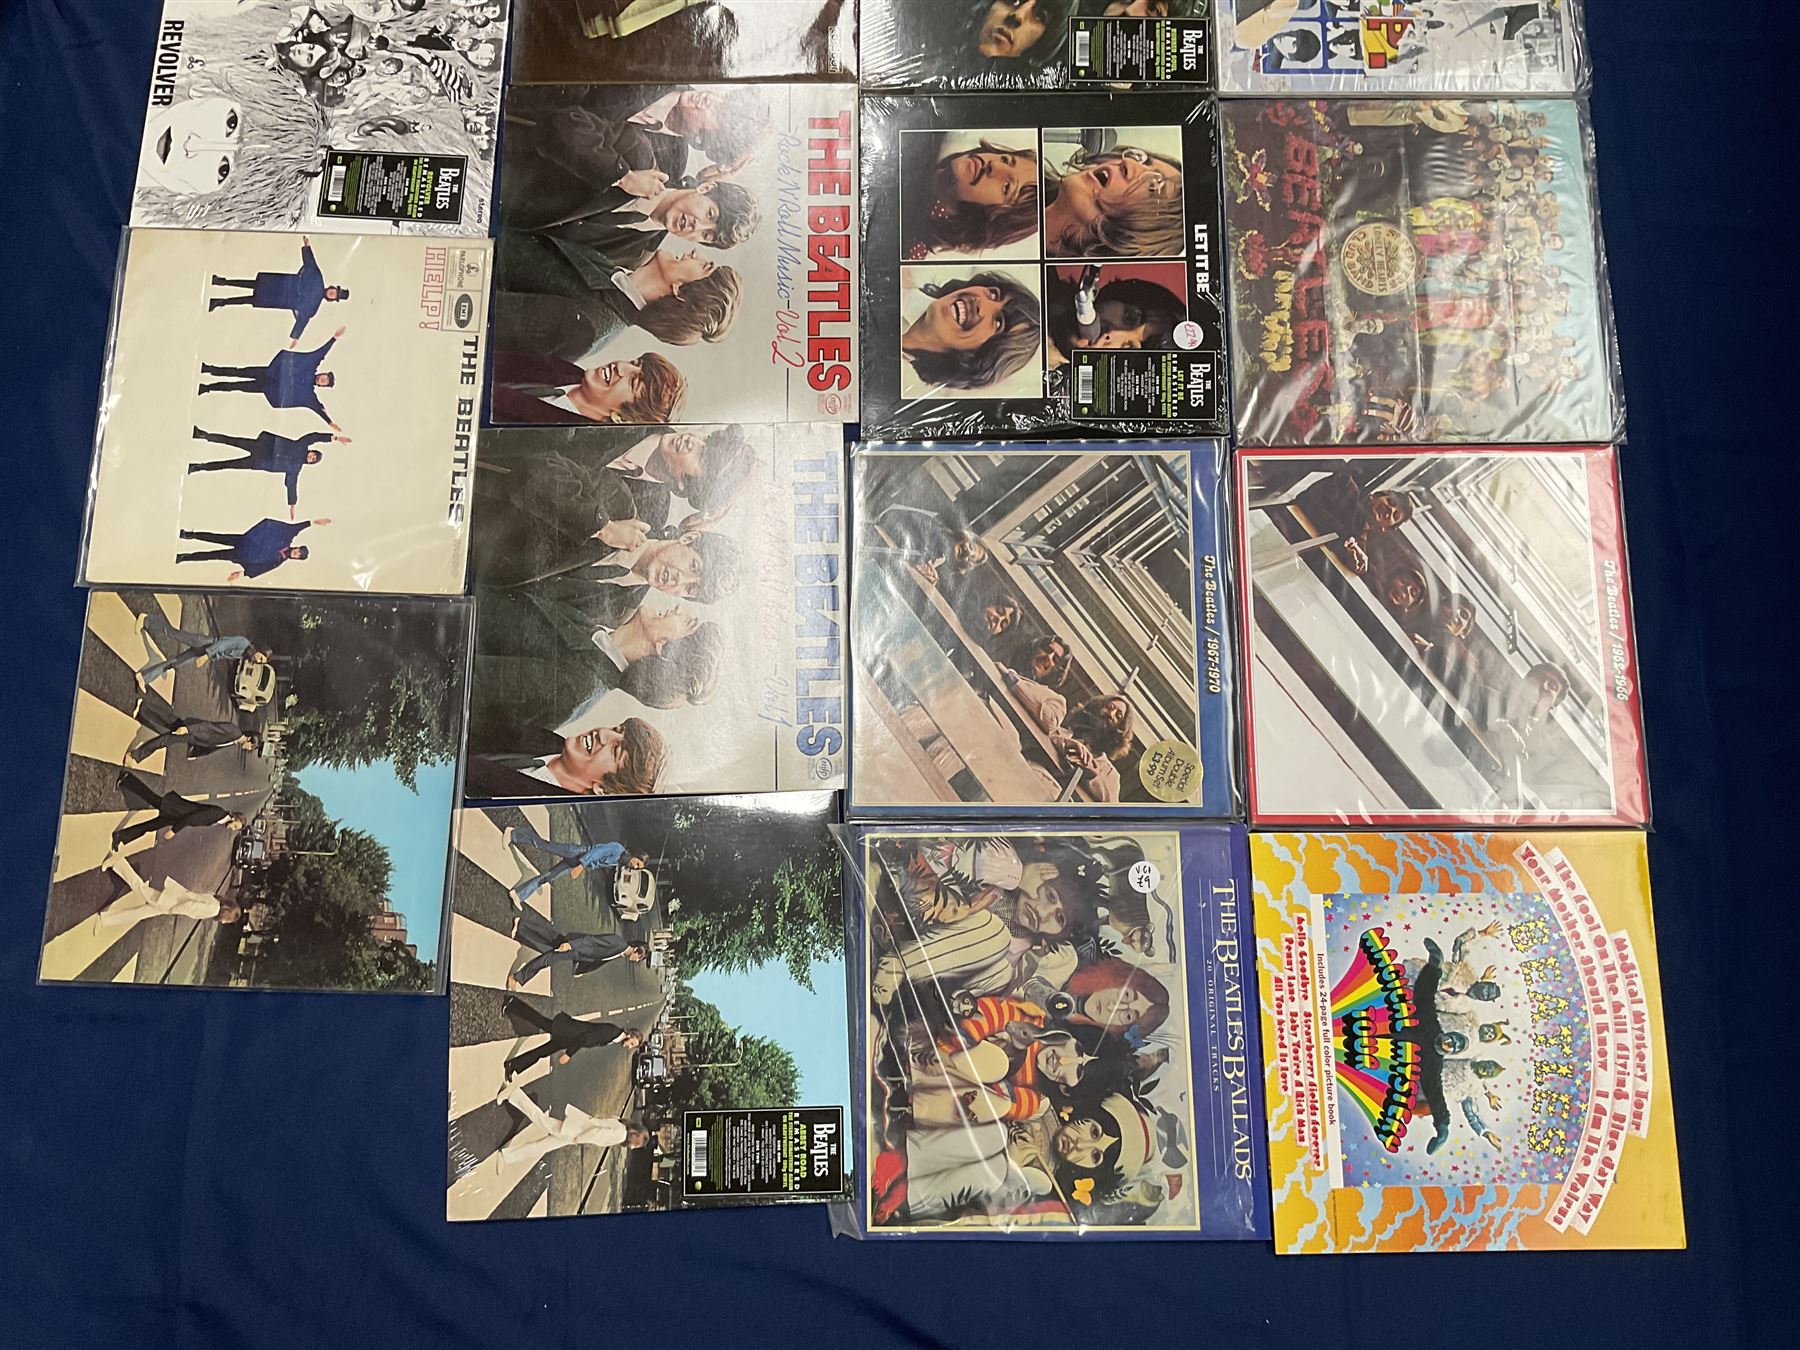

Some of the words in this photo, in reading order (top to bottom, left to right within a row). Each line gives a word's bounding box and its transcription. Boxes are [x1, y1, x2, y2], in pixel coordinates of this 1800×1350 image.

[152, 20, 184, 106] REVOLVER
[1180, 30, 1203, 70] BEATLES
[778, 133, 802, 176] Rock
[808, 110, 852, 196] THE
[417, 158, 429, 218] REMASTERED
[424, 171, 434, 204] REVOLVER
[435, 168, 460, 209] BEATLES
[476, 198, 484, 224] stereo
[777, 199, 801, 238] Roll
[1194, 224, 1208, 252] LET
[1346, 232, 1366, 258] CLUB
[1374, 226, 1384, 257] LONELY
[457, 250, 466, 288] PARLOPHONE
[777, 239, 801, 300] Music
[1196, 254, 1209, 270] IT
[1282, 134, 1333, 400] BEATLES
[1347, 261, 1373, 288] BAND
[1377, 261, 1387, 292] HEARTS
[419, 247, 446, 330] HELP!
[807, 205, 852, 393] BEATLES
[1196, 272, 1210, 293] BE
[775, 310, 802, 344] Vol
[460, 335, 478, 385] THE
[772, 341, 805, 368] 2
[1178, 392, 1184, 400] BE
[1187, 363, 1211, 407] BEATLES
[448, 398, 474, 525] BEATLES
[794, 451, 839, 545] THE
[1204, 556, 1216, 578] The
[1604, 560, 1616, 583] The
[1205, 581, 1217, 624] Beatles
[1607, 586, 1620, 630] Beatles
[1205, 627, 1219, 635] /
[795, 554, 842, 757] BEATLES
[1206, 638, 1221, 693] 1967-1970
[1612, 644, 1628, 700] 1962-1966
[764, 676, 790, 712] Vol
[758, 714, 792, 728] 1
[1158, 748, 1176, 775] Album
[1166, 758, 1184, 788] Double
[1176, 763, 1195, 792] Special
[1152, 775, 1164, 788] Set
[1137, 874, 1150, 889] £9
[1520, 848, 1551, 885] Your
[1553, 858, 1577, 891] The
[1212, 879, 1237, 933] THE
[1547, 888, 1586, 950] Mother
[1206, 959, 1213, 972] 20
[1285, 937, 1294, 972] Penny
[1594, 935, 1609, 960] On
[1287, 975, 1296, 1003] Lane
[1298, 951, 1310, 1001] Goodbye
[1317, 953, 1327, 989] Includes
[1361, 927, 1420, 1032] MAGICAL
[1581, 955, 1607, 1015] Should
[1603, 961, 1620, 996] The
[1614, 938, 1643, 1004] Magical
[1208, 980, 1216, 1036] ORIGINAL
[1215, 938, 1245, 1050] BEATLES
[1276, 995, 1284, 1015] You
[1319, 992, 1328, 1026] 24-page
[1288, 1011, 1299, 1038] Baby
[1322, 1029, 1330, 1043] full
[1351, 1005, 1379, 1071] TOUR
[1508, 917, 1574, 1158] BEATLES
[1280, 1053, 1289, 1063] Is
[1291, 1040, 1302, 1076] You're
[1303, 1011, 1316, 1078] Strawberry
[1324, 1045, 1332, 1067] color
[1596, 1022, 1610, 1071] Know
[1632, 1011, 1648, 1082] Mystery
[1210, 1046, 1219, 1092] TRACKS
[1280, 1066, 1290, 1092] Love
[1325, 1070, 1334, 1101] picture
[1295, 1091, 1306, 1116] Rich
[1378, 1041, 1422, 1153] MYSTERY
[1596, 1090, 1609, 1098] I
[1631, 1089, 1648, 1131] Tour
[1222, 1055, 1252, 1180] BALLADS
[1297, 1119, 1306, 1142] Man
[1328, 1104, 1336, 1125] book
[1606, 1112, 1626, 1151] Blue
[810, 1123, 836, 1177] BEATLES
[1581, 1135, 1602, 1167] The
[1553, 1173, 1590, 1226] Walrus
[1578, 1193, 1602, 1224] Way
